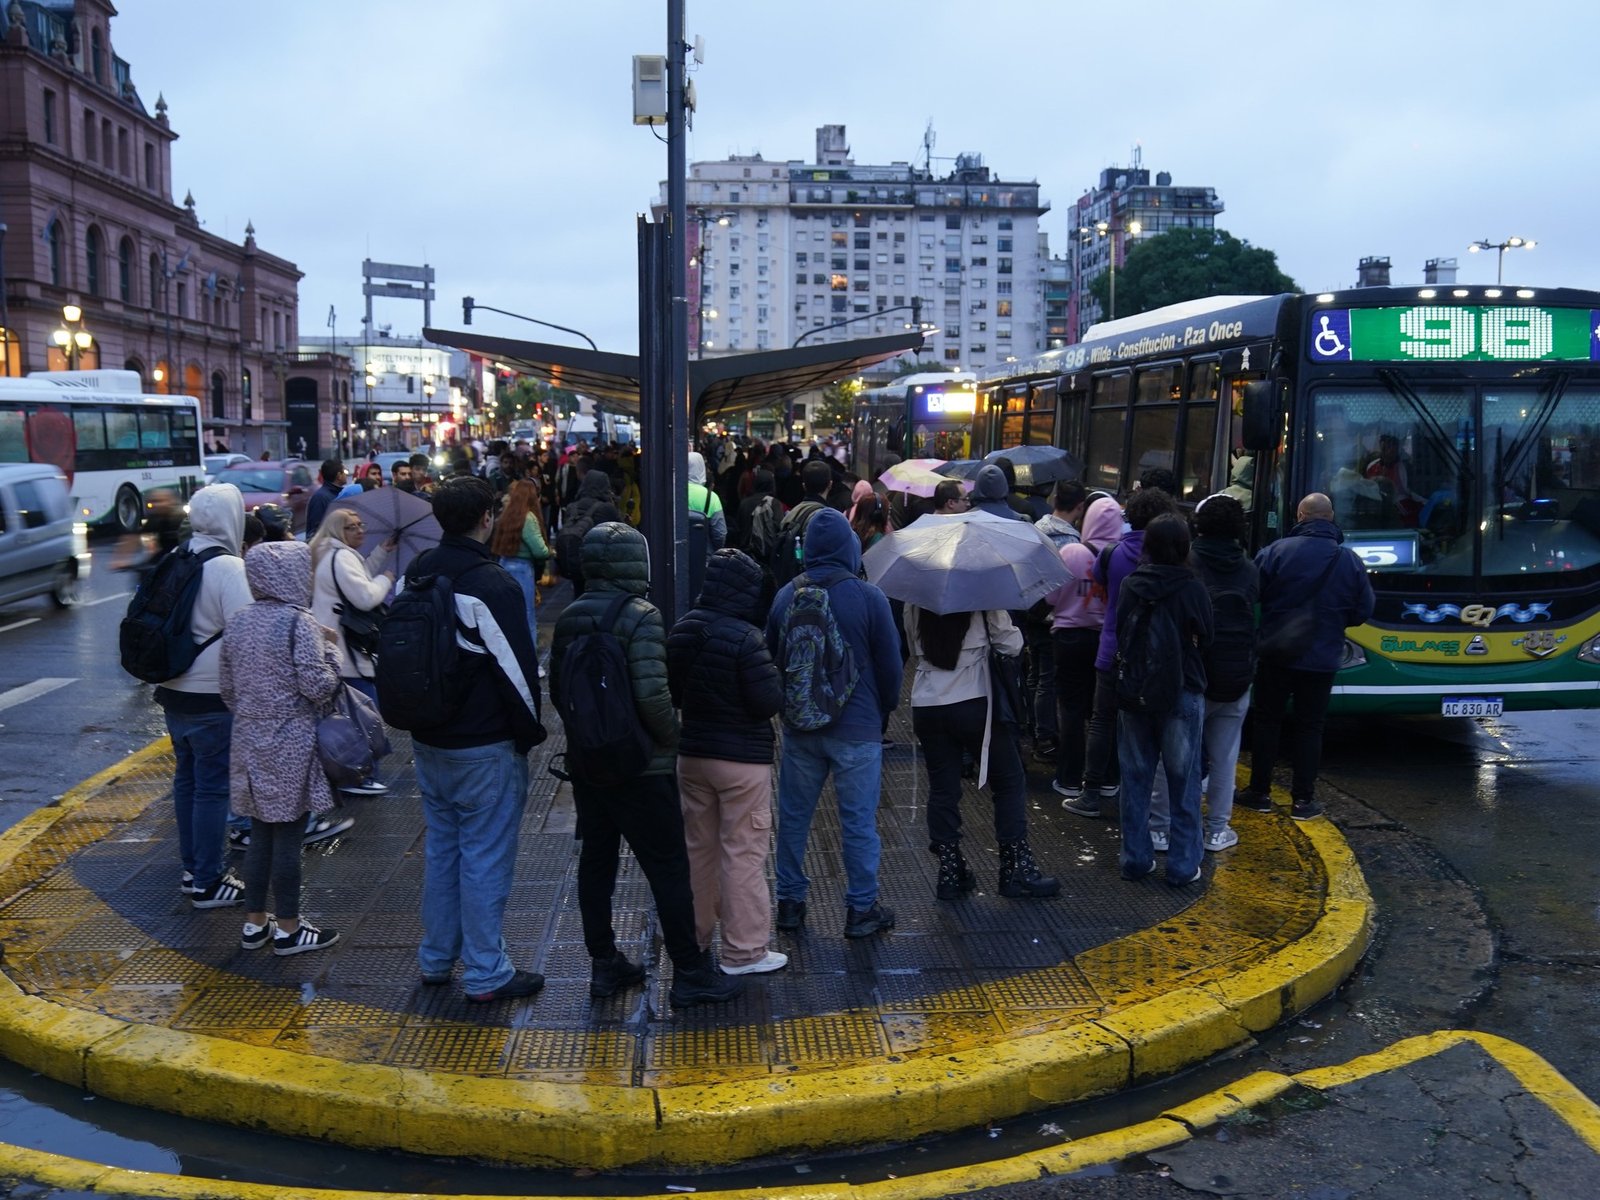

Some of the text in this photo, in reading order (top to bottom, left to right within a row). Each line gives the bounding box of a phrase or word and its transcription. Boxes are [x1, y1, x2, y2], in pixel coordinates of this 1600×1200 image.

[1065, 348, 1086, 369] 98
[1090, 346, 1111, 363] Wilde
[1117, 333, 1175, 358] Constitucion
[1184, 326, 1206, 346] P.za
[1208, 320, 1243, 342] Once
[1400, 306, 1553, 358] 98
[1381, 640, 1460, 653] QUILMES
[1445, 703, 1500, 715] AC 830 AR
